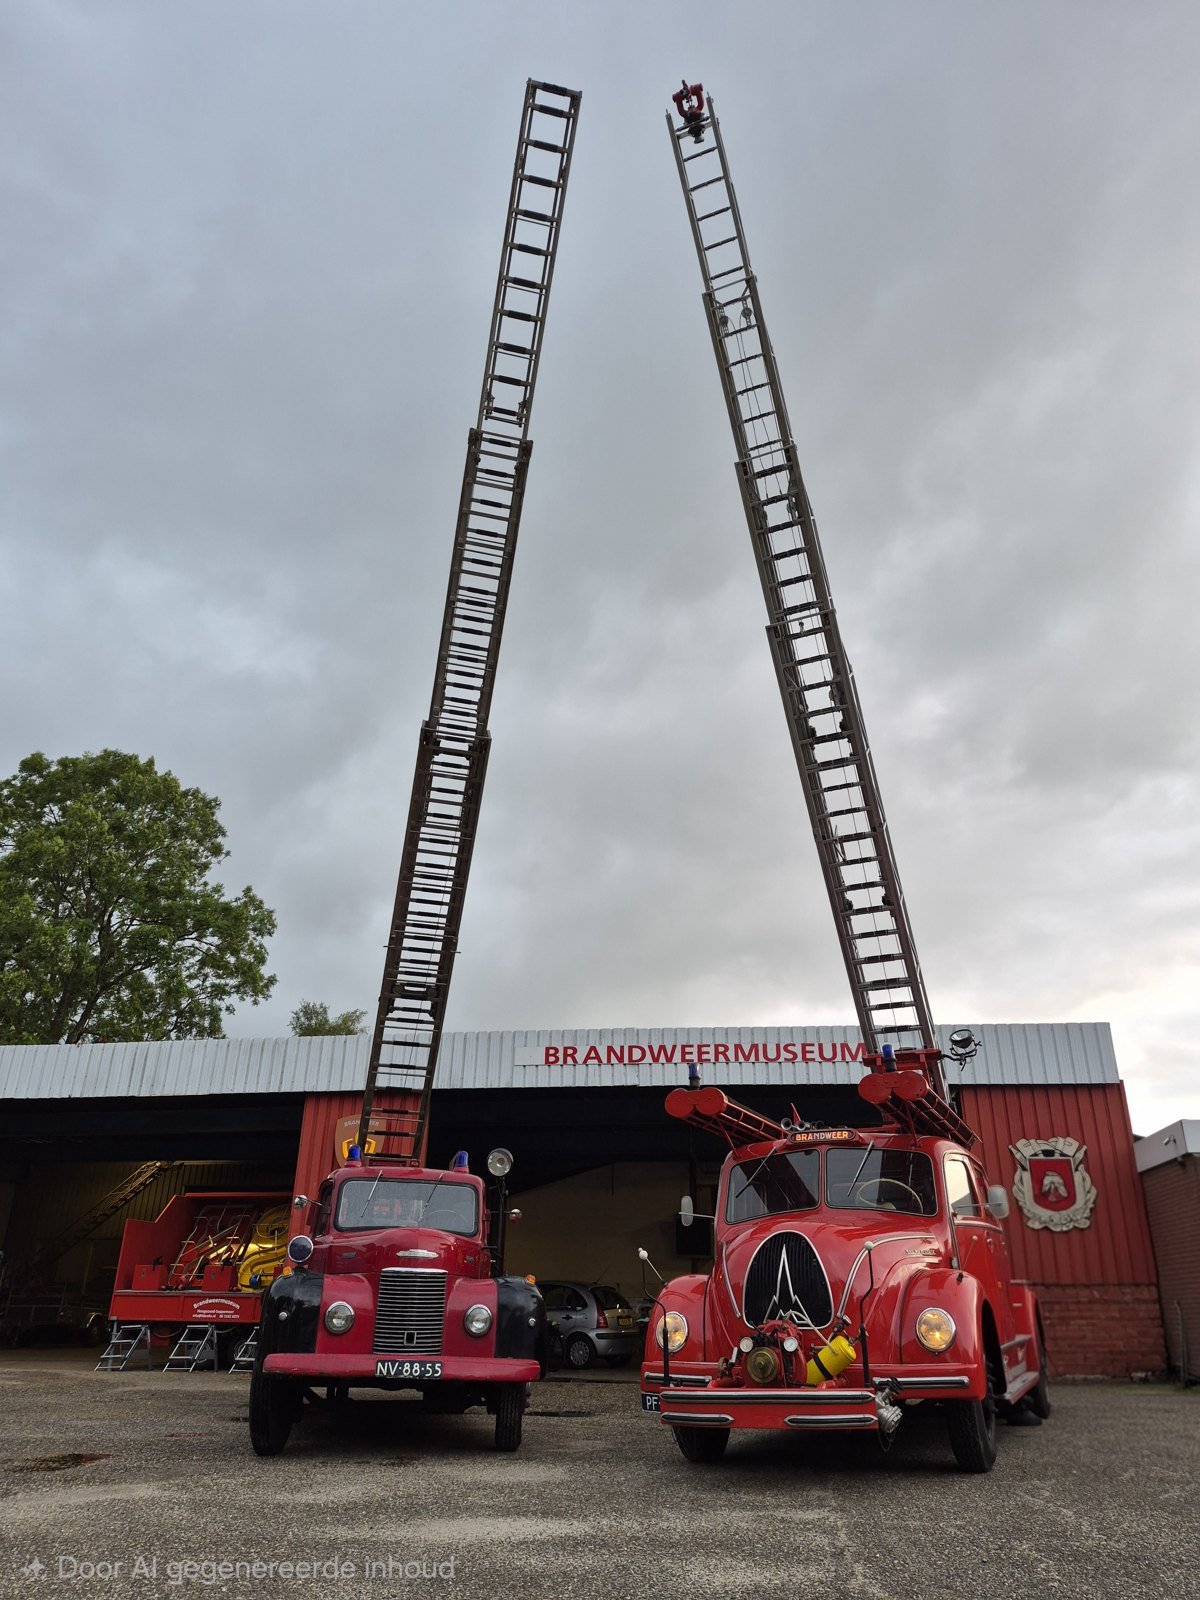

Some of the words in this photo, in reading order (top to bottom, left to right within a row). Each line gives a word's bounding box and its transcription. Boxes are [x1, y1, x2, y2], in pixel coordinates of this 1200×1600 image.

[544, 1042, 867, 1065] BRANDWEERMUSEUM
[344, 1119, 379, 1127] BRANEER
[795, 1131, 849, 1141] BRANDWEER
